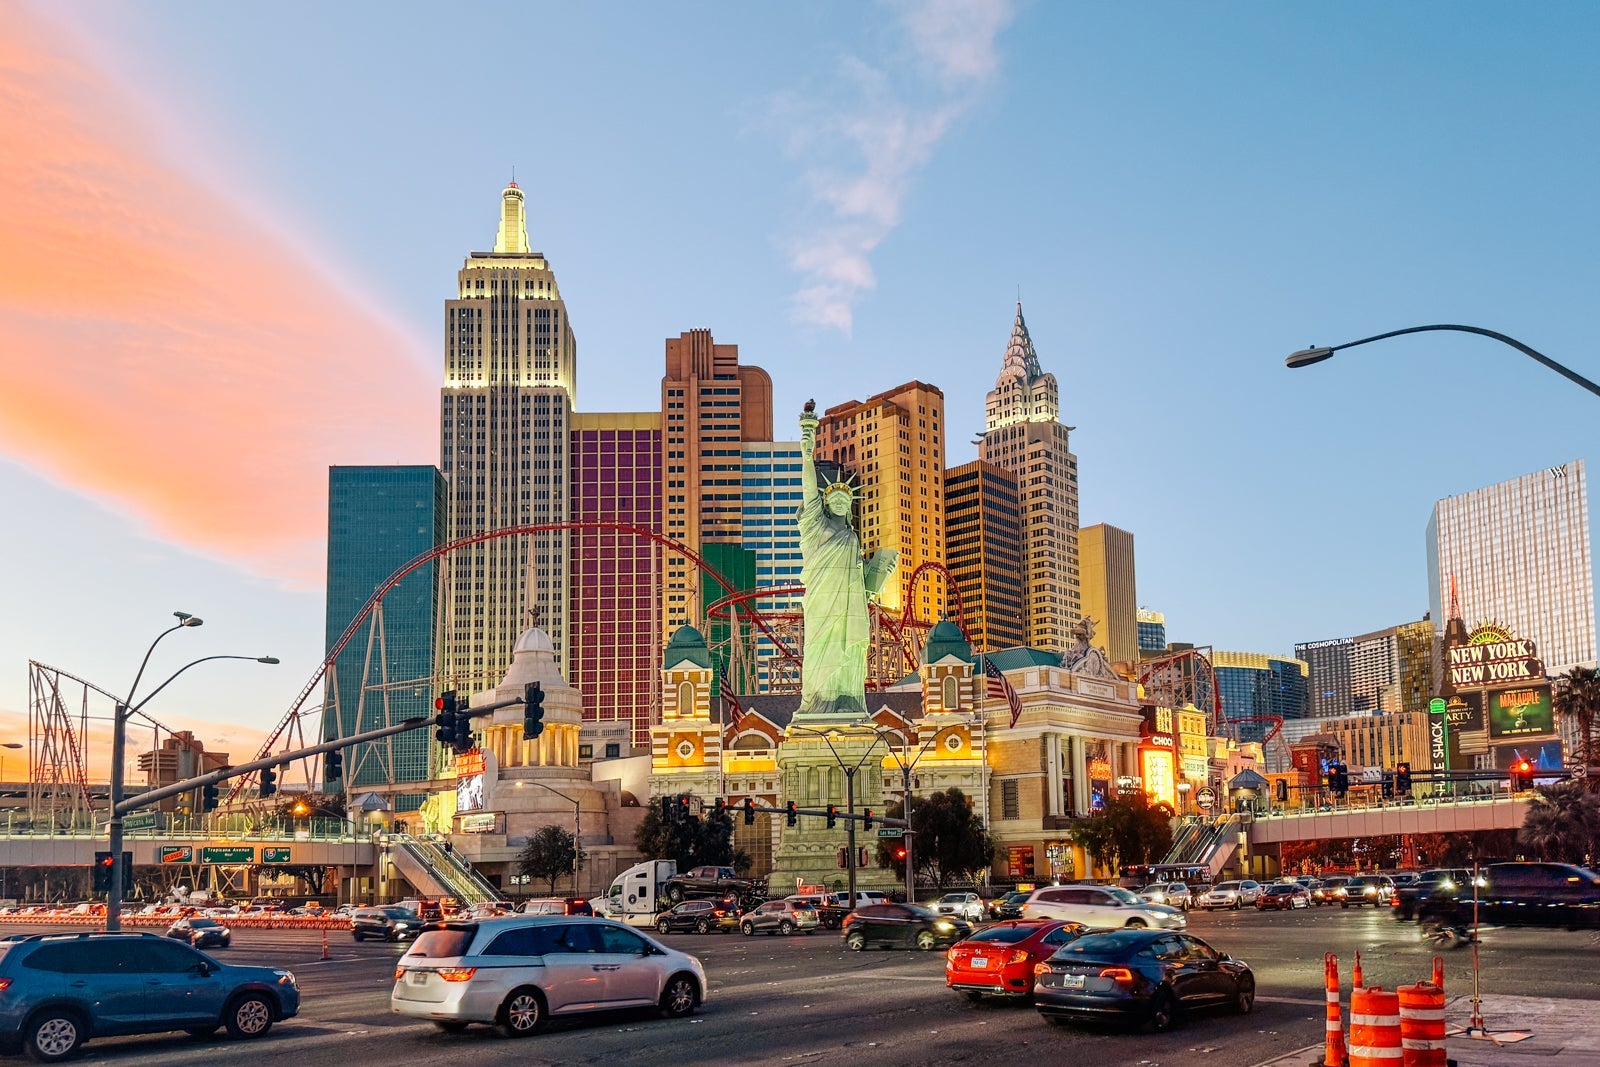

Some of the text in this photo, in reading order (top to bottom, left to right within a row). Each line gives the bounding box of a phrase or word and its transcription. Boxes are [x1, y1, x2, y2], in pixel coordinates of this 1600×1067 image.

[1307, 637, 1354, 650] COSMOPOLITAN
[1450, 641, 1529, 664] NEW YORK
[1451, 660, 1530, 684] NEW YORK
[1517, 691, 1540, 705] APPLE
[1446, 711, 1474, 721] ARTY.
[1431, 721, 1445, 758] SHACK
[123, 816, 155, 828] Tropicana Ave
[164, 851, 183, 861] CLOSED
[183, 849, 189, 857] 15
[267, 850, 274, 858] 15
